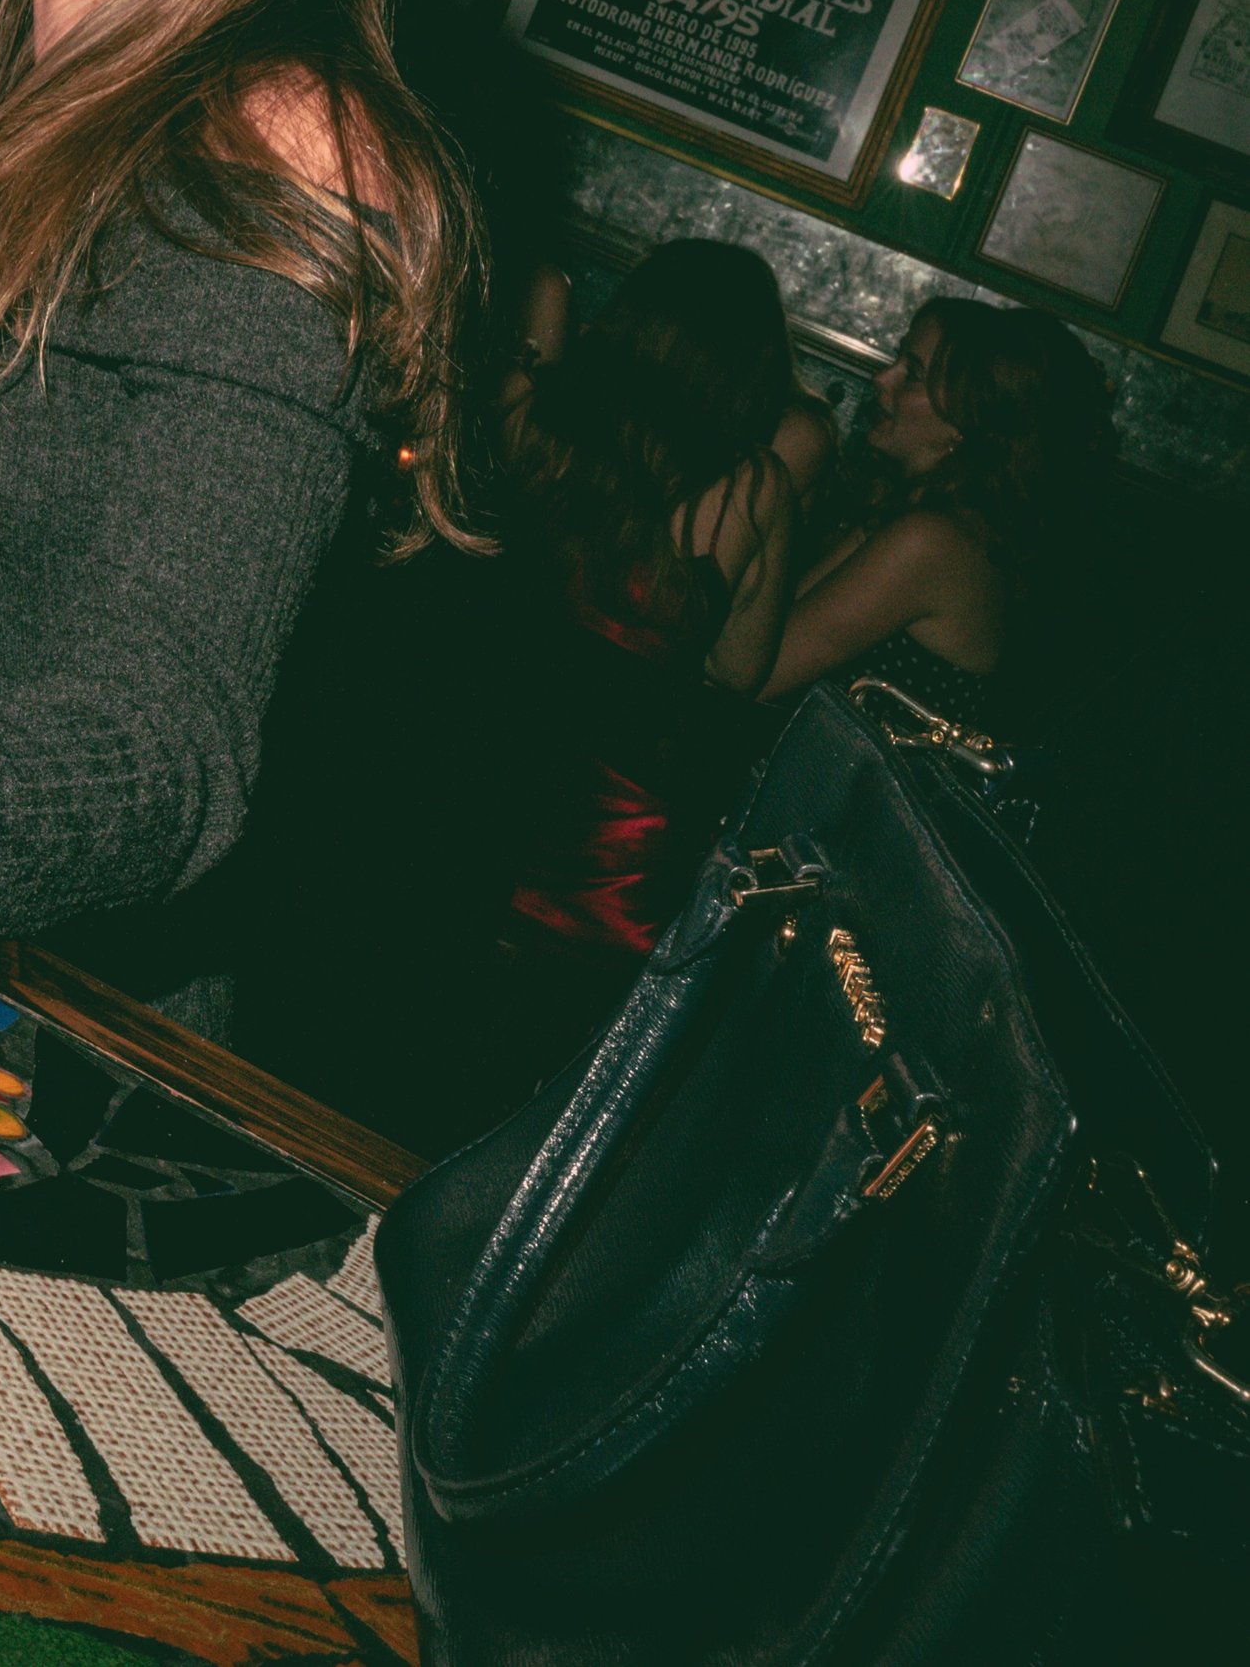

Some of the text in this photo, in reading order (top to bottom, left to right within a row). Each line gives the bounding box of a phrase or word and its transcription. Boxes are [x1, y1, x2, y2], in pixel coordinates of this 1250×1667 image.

[567, 20, 580, 30] EN
[582, 26, 592, 36] EL
[596, 32, 635, 53] PALACIO
[637, 49, 650, 59] DE
[652, 56, 668, 67] LOS
[671, 63, 720, 89] DEPORTES
[644, 2, 757, 58] ENERO DE 1995
[594, 45, 625, 62] MIXUP
[635, 62, 697, 94] DISCOLANDIA
[637, 36, 740, 84] BOLETOS DISPONIBLES
[653, 25, 741, 73] HERMANOS
[744, 62, 838, 112] RODRÍGUEZ
[879, 1162, 915, 1202] MICHAEL
